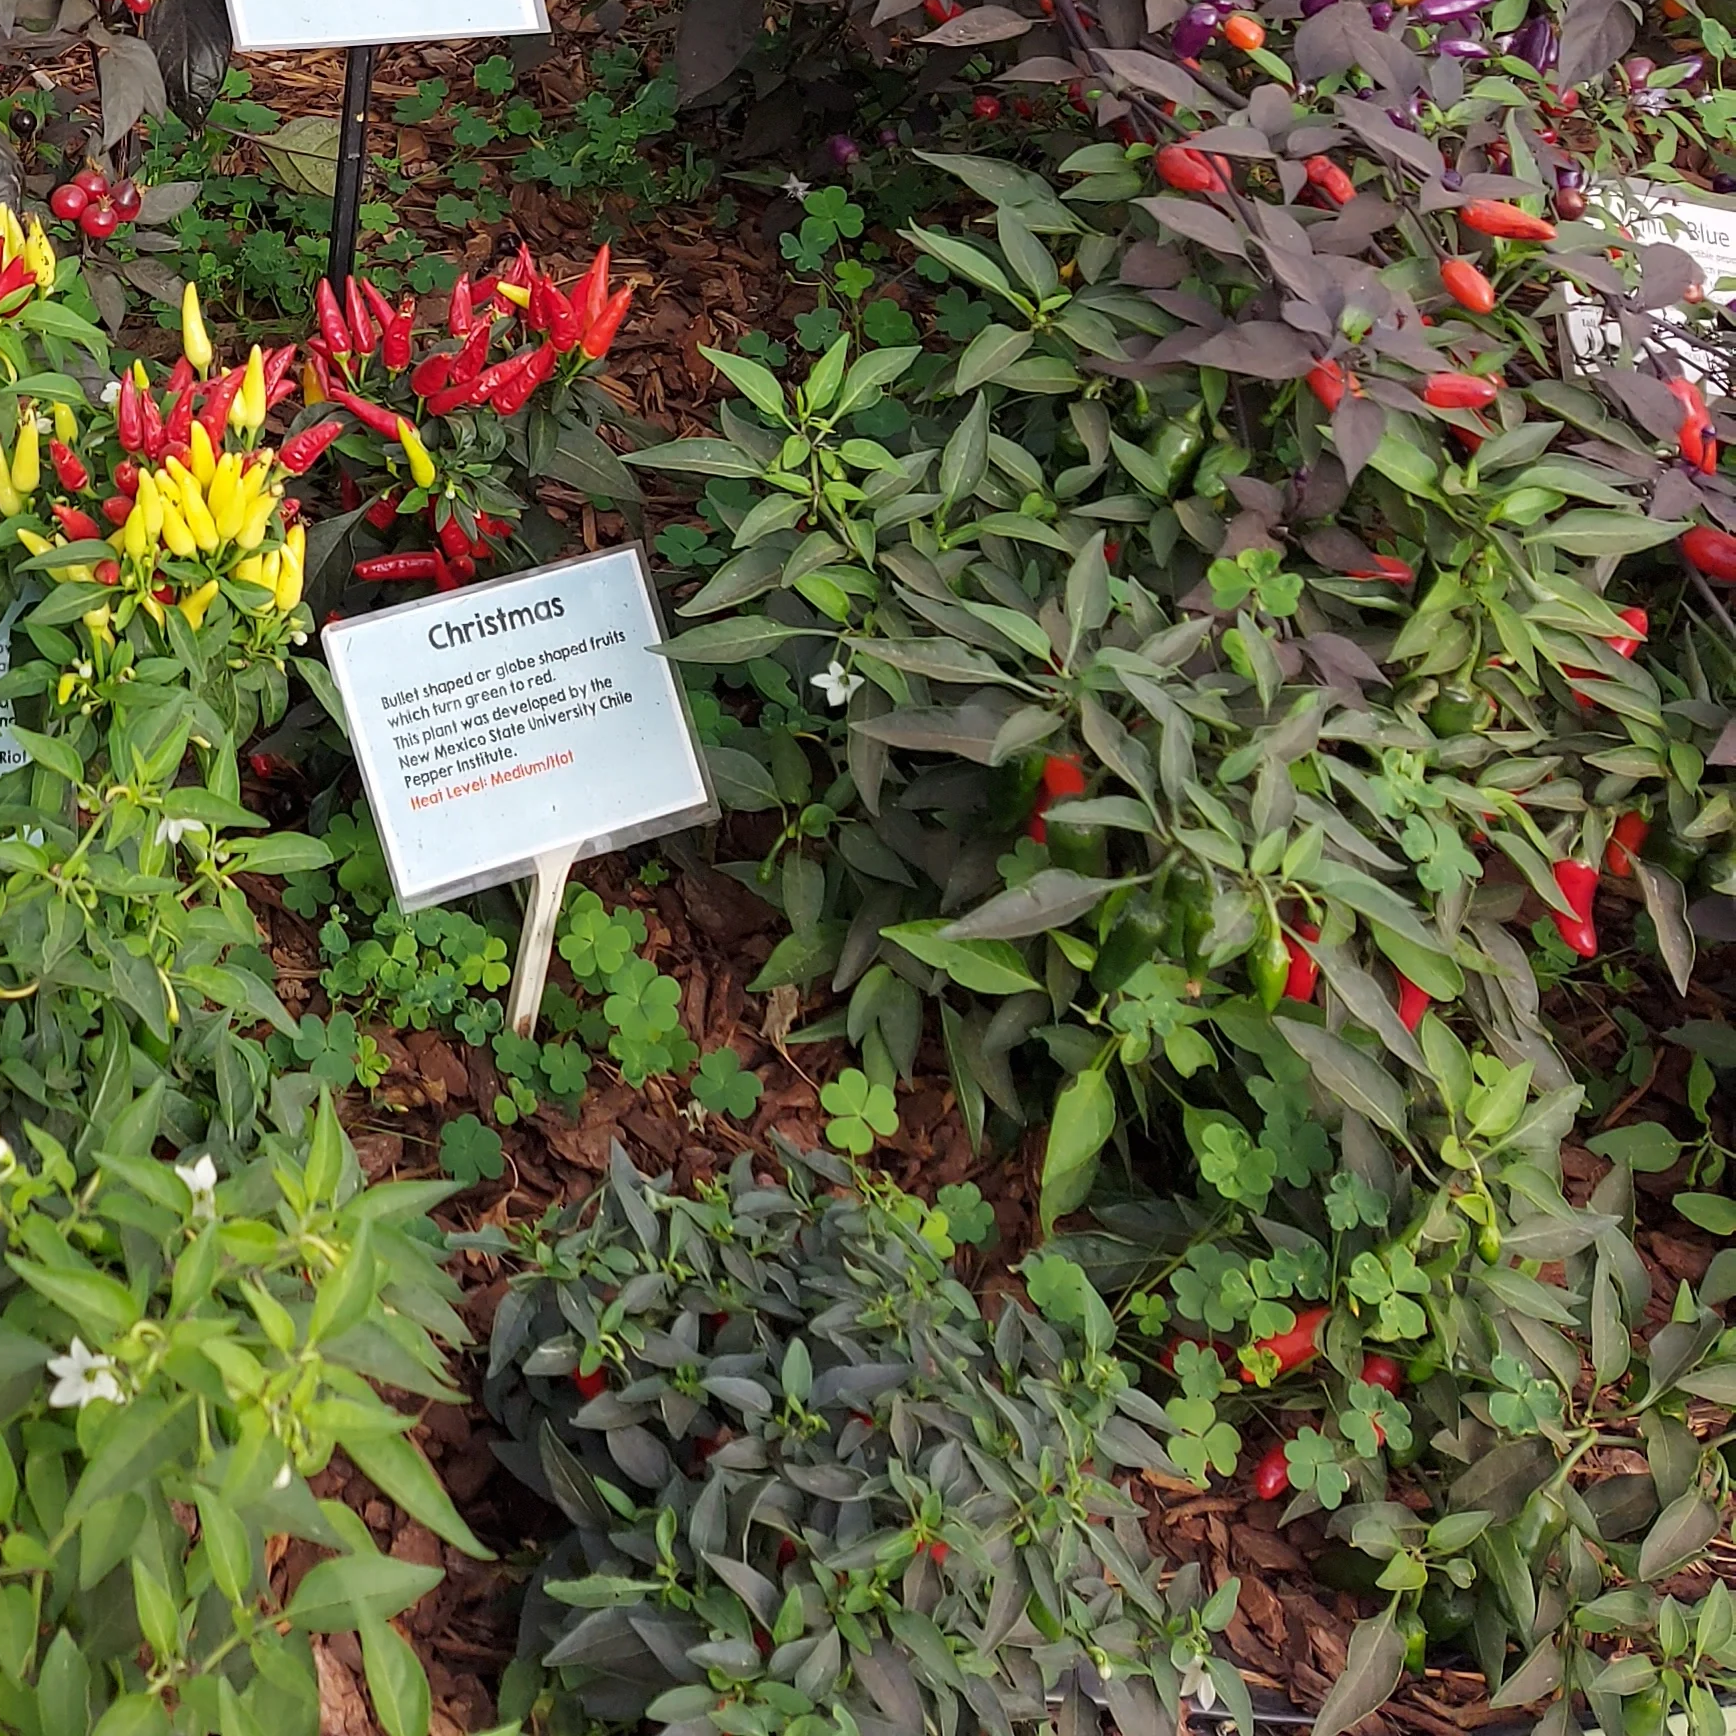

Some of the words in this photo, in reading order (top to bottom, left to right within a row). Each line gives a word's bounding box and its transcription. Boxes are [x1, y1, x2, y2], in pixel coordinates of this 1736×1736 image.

[428, 596, 565, 650] Christmas
[381, 687, 419, 711] Bullet
[423, 672, 474, 699] shaped
[477, 668, 491, 683] or
[496, 656, 536, 680] globe
[538, 639, 587, 665] shaped
[590, 630, 626, 651] fruits
[387, 706, 430, 729] which
[433, 698, 462, 716] turn
[466, 686, 508, 709] green
[510, 679, 525, 694] to
[527, 669, 556, 690] red.
[393, 732, 420, 752] This
[422, 719, 459, 745] plant
[461, 712, 490, 732] was
[493, 689, 566, 722] developed
[569, 683, 589, 701] by
[590, 676, 613, 693] the
[398, 751, 430, 772] New
[434, 735, 487, 761] Mexico
[488, 720, 526, 743] State
[528, 701, 596, 732] University
[599, 691, 633, 711] Chile
[0, 750, 27, 764] Riot
[404, 763, 453, 790] Pepper
[456, 746, 518, 772] Institute.
[410, 789, 444, 811] Heat
[446, 777, 487, 800] Level:
[490, 749, 575, 788] Medium/Hot
